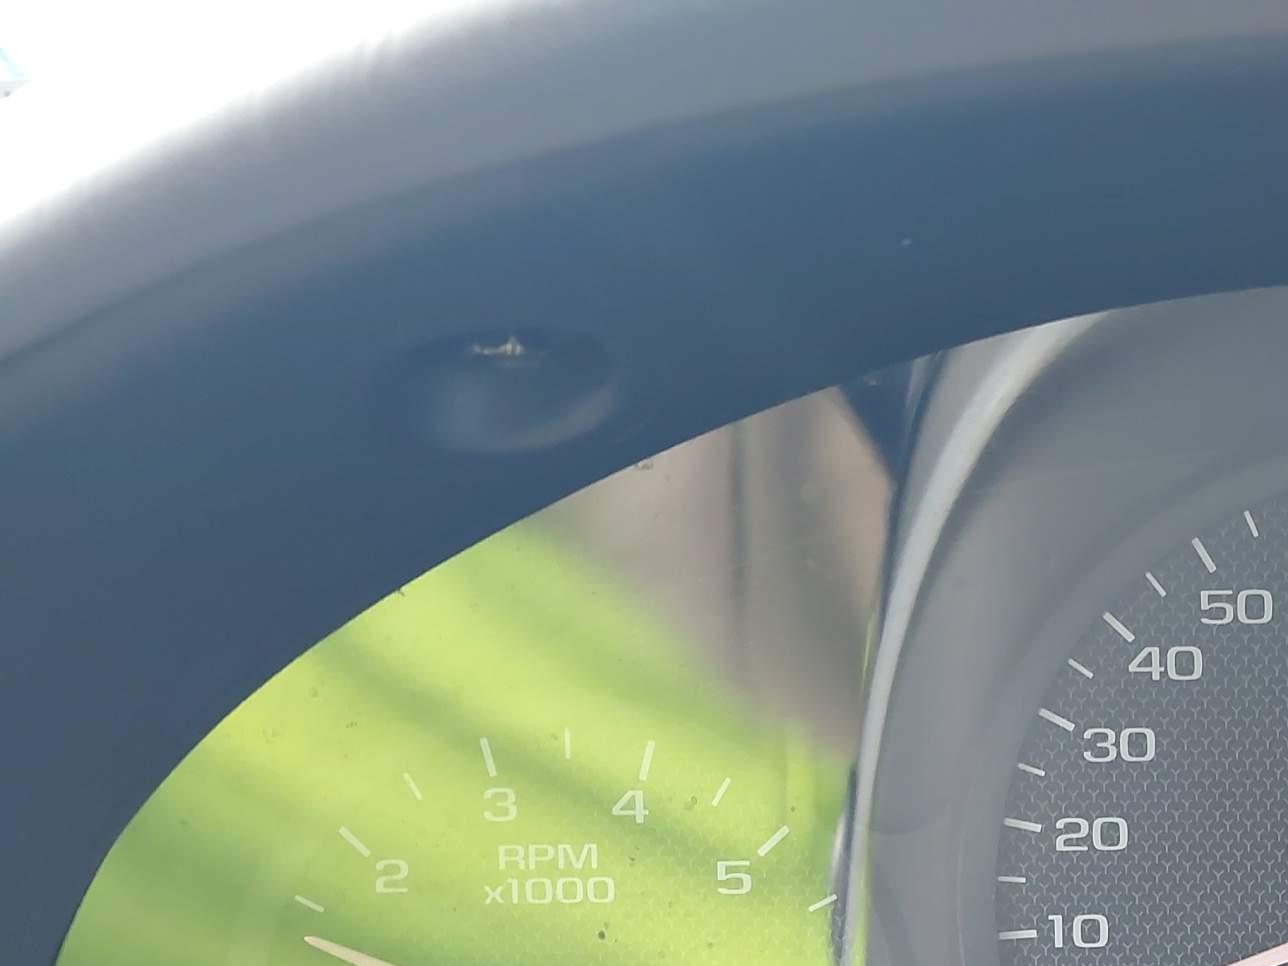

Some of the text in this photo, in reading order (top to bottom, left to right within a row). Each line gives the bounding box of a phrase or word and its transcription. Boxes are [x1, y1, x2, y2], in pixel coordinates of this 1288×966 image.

[1200, 589, 1273, 625] 50
[1128, 646, 1203, 681] 40
[1082, 727, 1156, 762] 30
[483, 788, 518, 822] 3
[612, 790, 649, 824] 4
[1055, 817, 1129, 852] 20
[498, 843, 599, 869] RPM
[375, 859, 410, 894] 2
[484, 876, 615, 905] x1000
[716, 860, 752, 896] 5
[1048, 914, 1110, 948] 10
